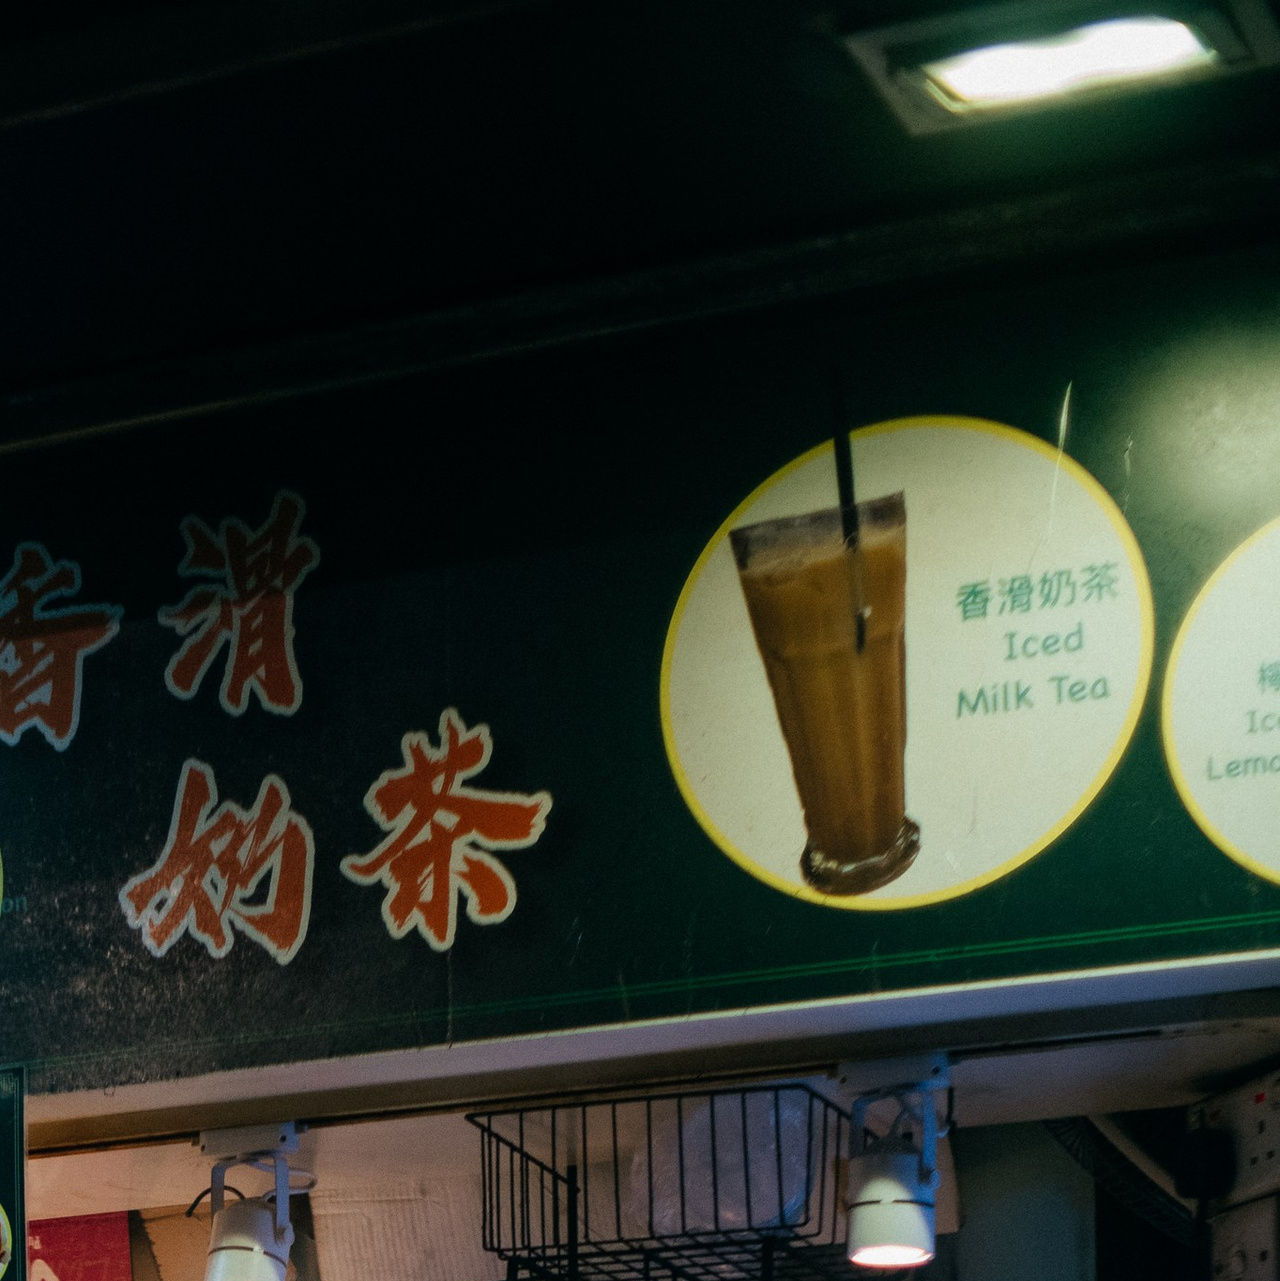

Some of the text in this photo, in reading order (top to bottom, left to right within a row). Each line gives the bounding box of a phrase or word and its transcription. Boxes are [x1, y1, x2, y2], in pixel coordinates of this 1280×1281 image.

[957, 560, 1119, 621] 香滑奶茶
[1003, 620, 1084, 661] Iced
[956, 675, 1112, 720] Milk Tea
